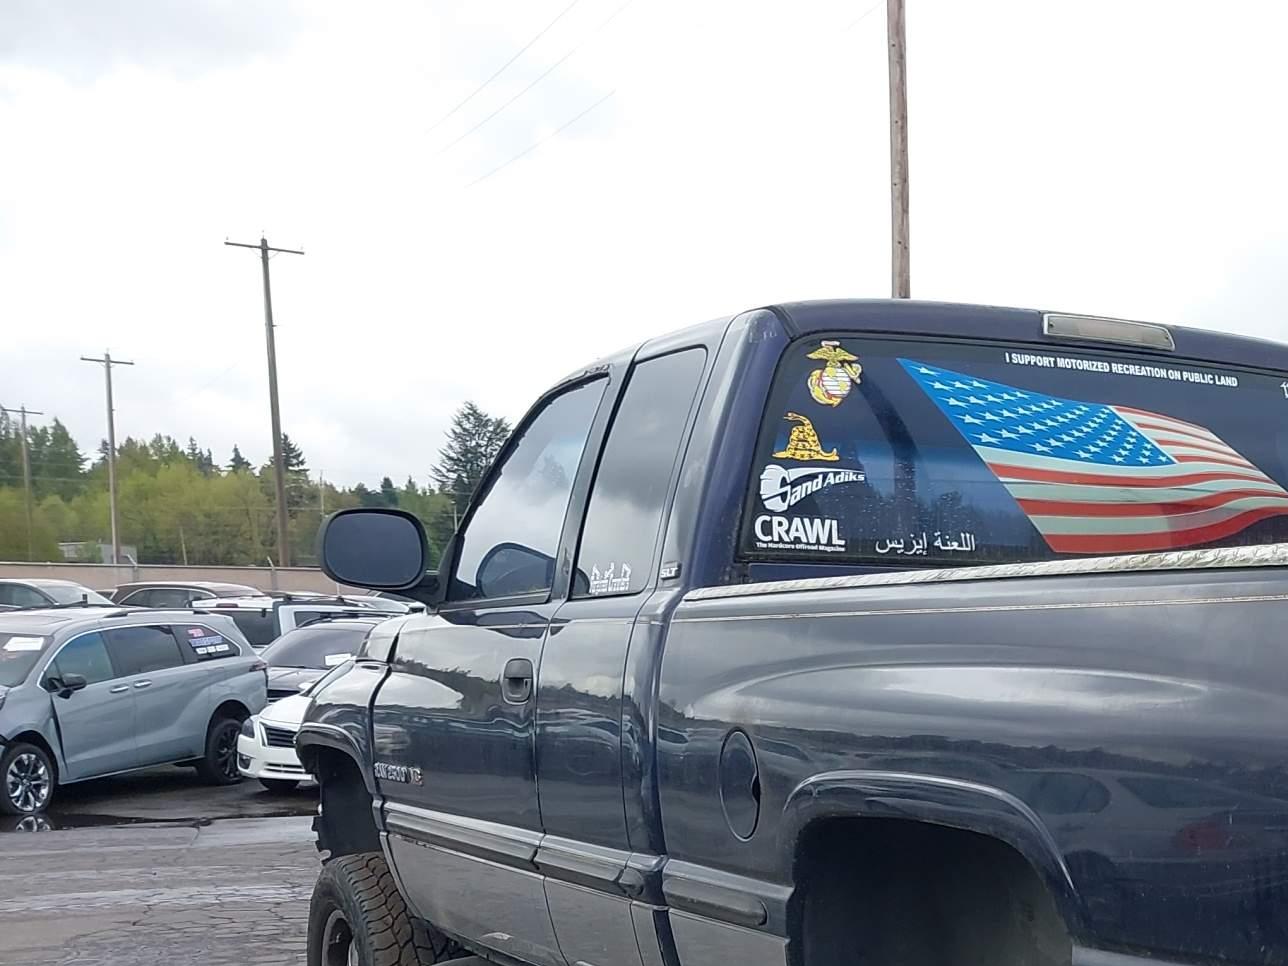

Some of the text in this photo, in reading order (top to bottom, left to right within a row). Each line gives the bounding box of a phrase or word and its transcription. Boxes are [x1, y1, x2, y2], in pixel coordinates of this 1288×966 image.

[1005, 352, 1238, 387] I SUPPORT MOTORIZED RECREATION ON PUBLIC LAND
[754, 515, 846, 545] CRAWL
[875, 532, 976, 555] اللعنة إيزيس
[660, 567, 679, 578] SLT
